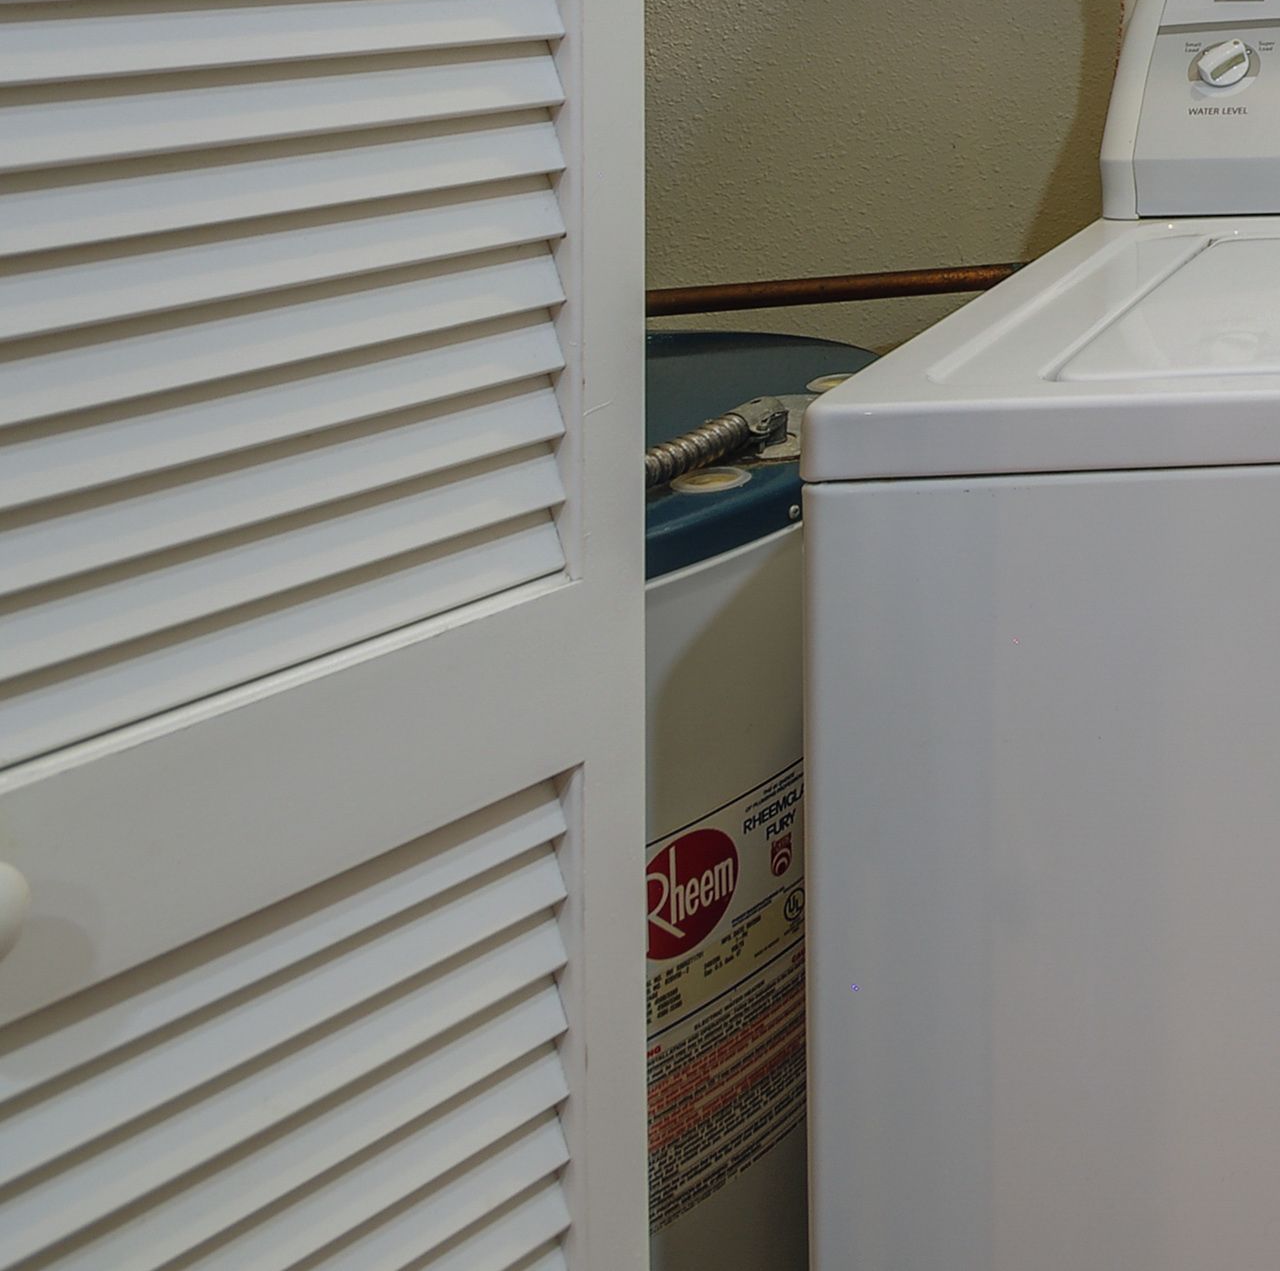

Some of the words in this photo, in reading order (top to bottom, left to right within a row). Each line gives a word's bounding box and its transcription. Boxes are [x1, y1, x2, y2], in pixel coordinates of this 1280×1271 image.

[1188, 107, 1220, 116] WATER
[1221, 107, 1248, 115] LEVEL
[766, 808, 796, 841] FURY
[647, 845, 733, 940] Rheem
